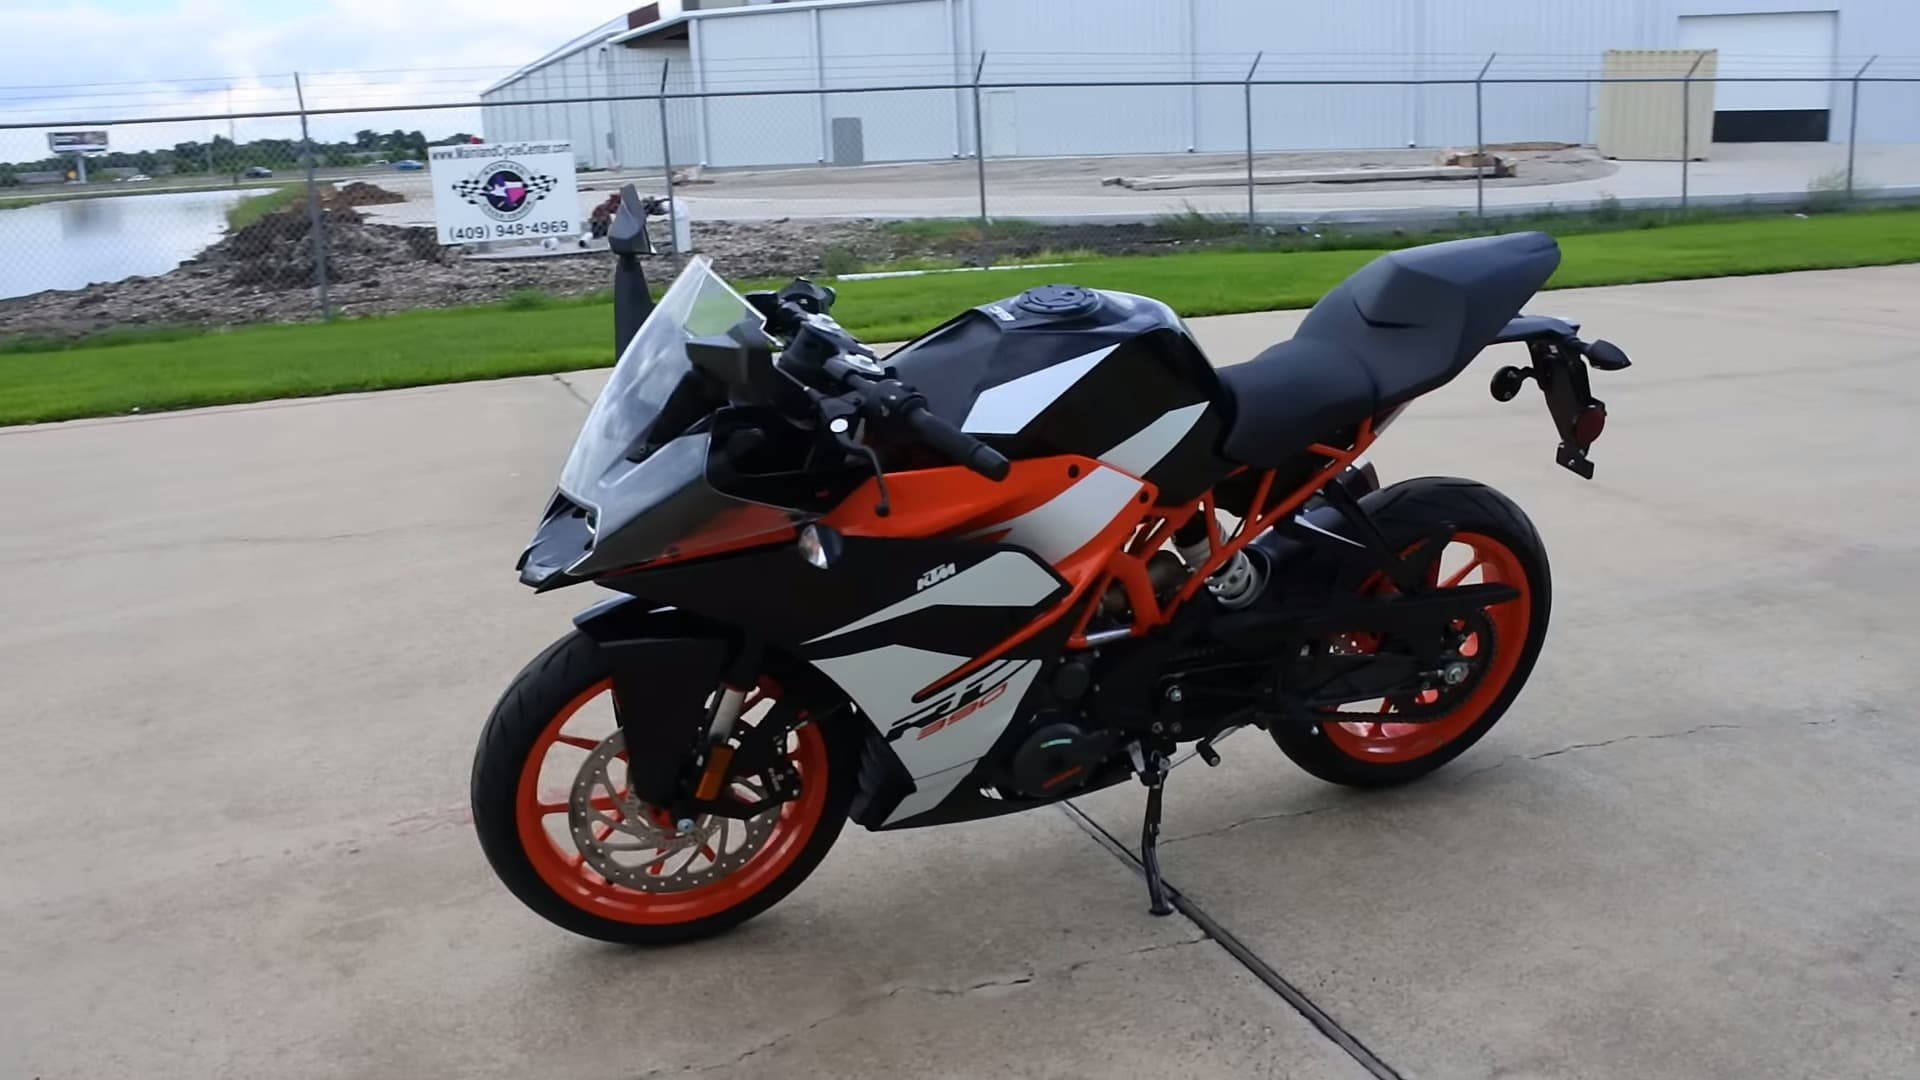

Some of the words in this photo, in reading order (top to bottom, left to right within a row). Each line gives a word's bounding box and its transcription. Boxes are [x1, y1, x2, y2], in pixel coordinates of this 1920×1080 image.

[432, 142, 572, 159] www.MainlandCycleCenter.com
[449, 226, 490, 240] (409)
[496, 220, 569, 237] 948-4969
[917, 562, 956, 591] KTM
